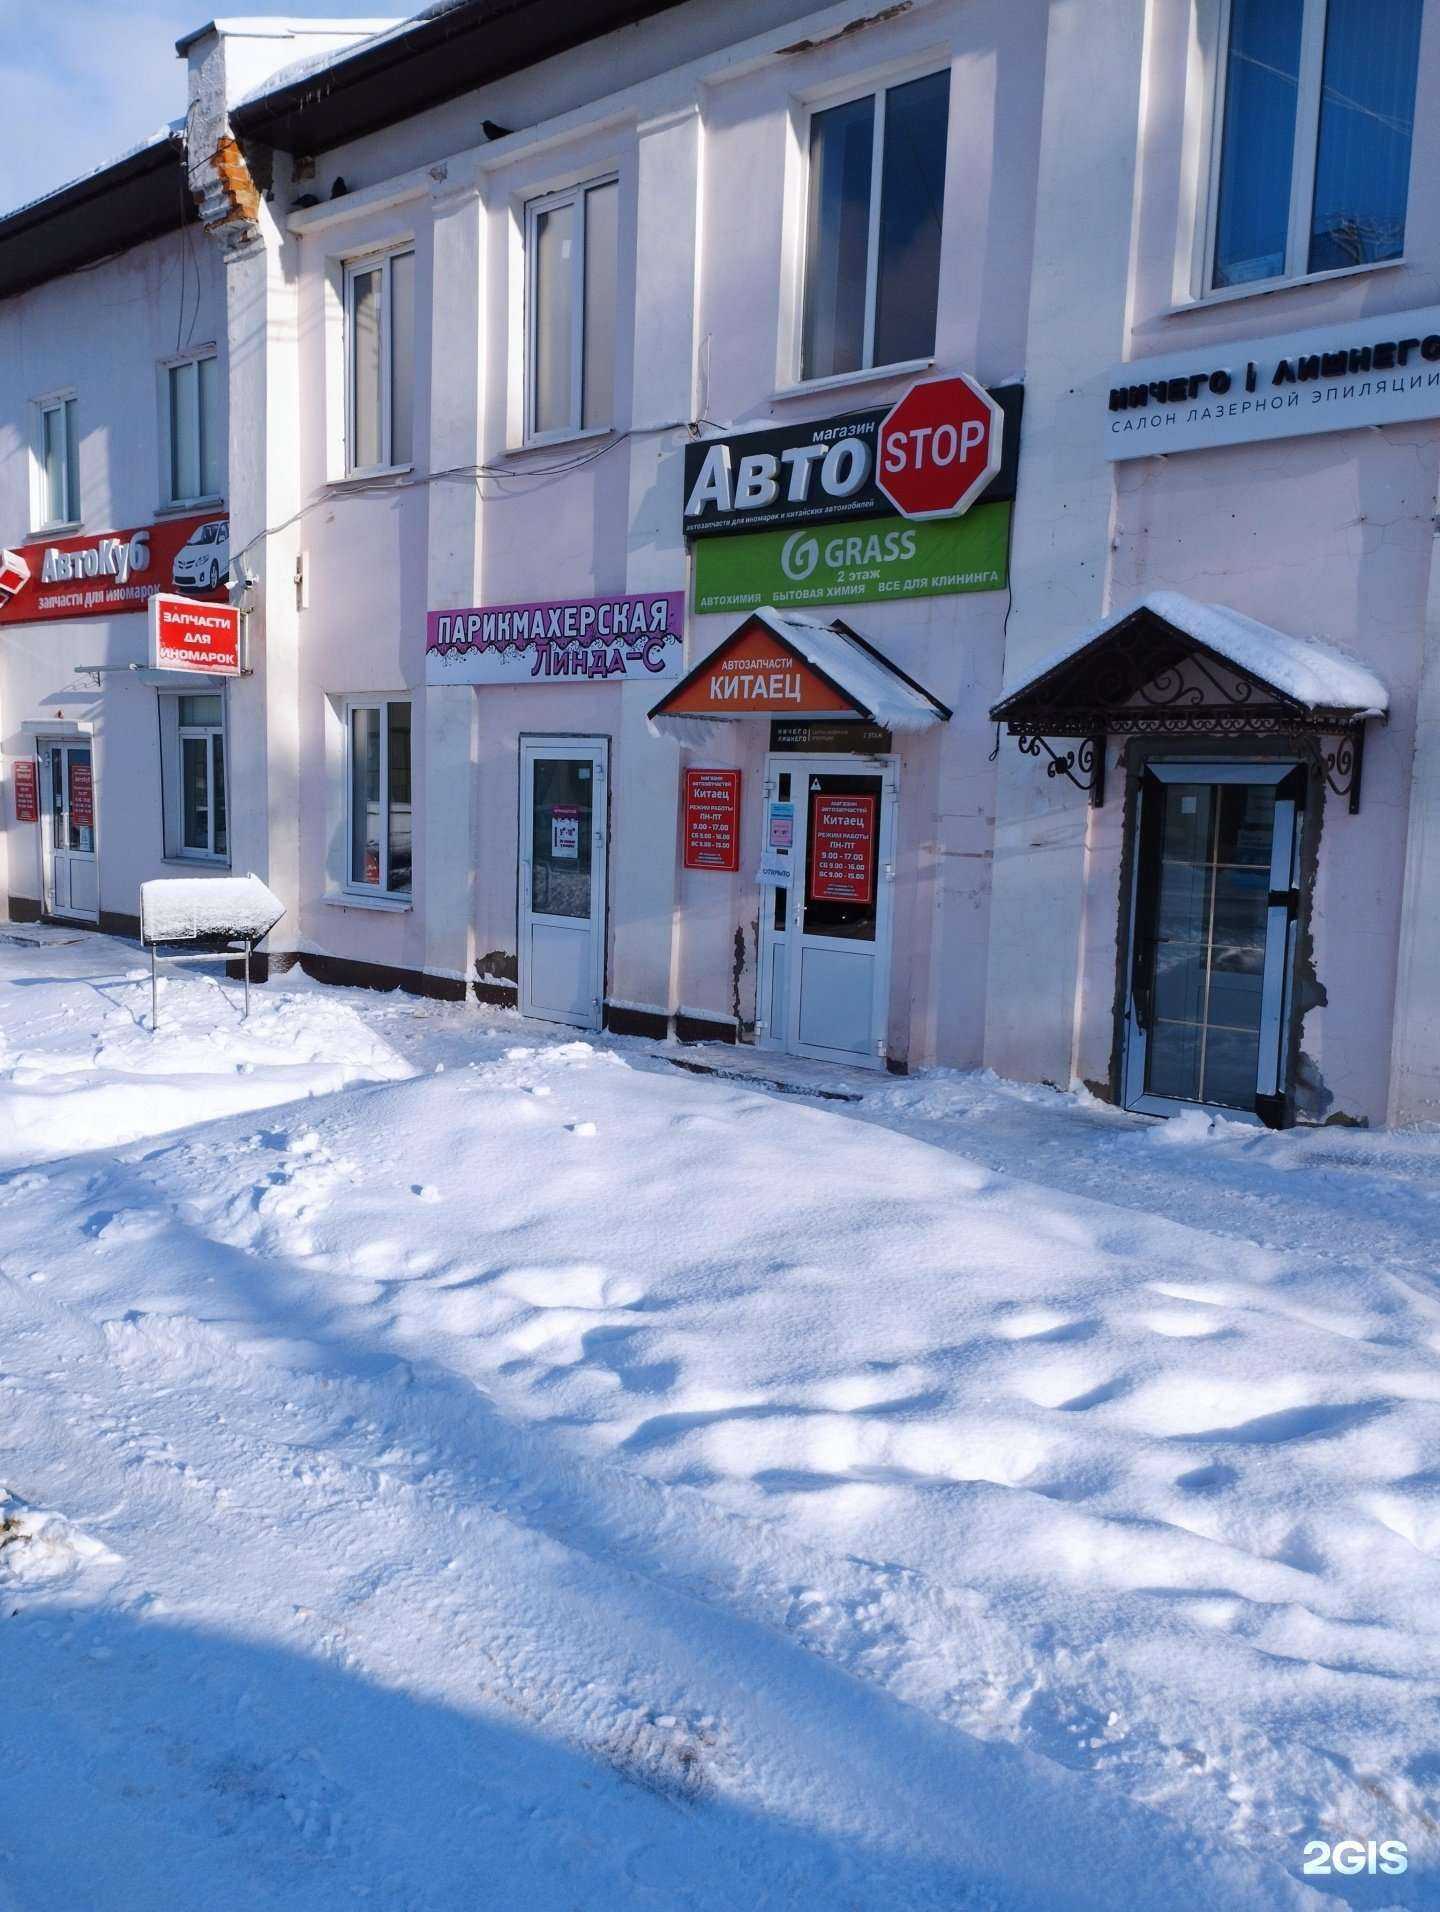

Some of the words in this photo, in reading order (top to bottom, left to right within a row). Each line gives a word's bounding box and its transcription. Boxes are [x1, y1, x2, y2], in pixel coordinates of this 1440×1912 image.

[1108, 369, 1232, 412] НИЧЕГО
[1271, 334, 1440, 386] ЛИШНЕГО
[1111, 412, 1176, 433] САЛОН
[1186, 392, 1299, 423] ЛАЗЕРНОЙ
[1312, 372, 1440, 403] ЭПИЛЯЦИИ
[813, 421, 875, 443] магазин
[884, 419, 985, 473] STOP
[685, 518, 731, 531] автозапчасти
[731, 517, 745, 527] для
[745, 513, 780, 524] иномарок
[786, 507, 823, 518] китайских
[824, 499, 875, 513] автомобилей
[824, 529, 917, 568] GRASS
[837, 570, 847, 582] 2
[848, 568, 881, 582] этаж
[38, 592, 83, 610] запчасти
[83, 590, 104, 608] для
[105, 584, 161, 603] иномарок
[700, 592, 762, 607] АВТОХИМИЯ
[772, 588, 824, 601] БЫТОВАЯ
[826, 584, 866, 597] ХИМИЯ
[878, 581, 900, 593] ВСЕ
[903, 578, 928, 591] ДЛЯ
[931, 570, 998, 587] КЛИНИНГА
[163, 612, 231, 630] ЗАПЧАСТИ
[437, 599, 669, 644] ПАРИКМАХЕРСКАЯ
[183, 632, 212, 645] ДЛЯ
[160, 647, 236, 664] ИНОМАРОК
[721, 657, 793, 671] АВТОЗАПЧАСТИ
[709, 673, 801, 703] КИТАЕЦ
[694, 788, 730, 801] Китаец
[823, 814, 865, 829] Китаец
[821, 852, 838, 860] 9.00
[843, 853, 864, 861] 17.00
